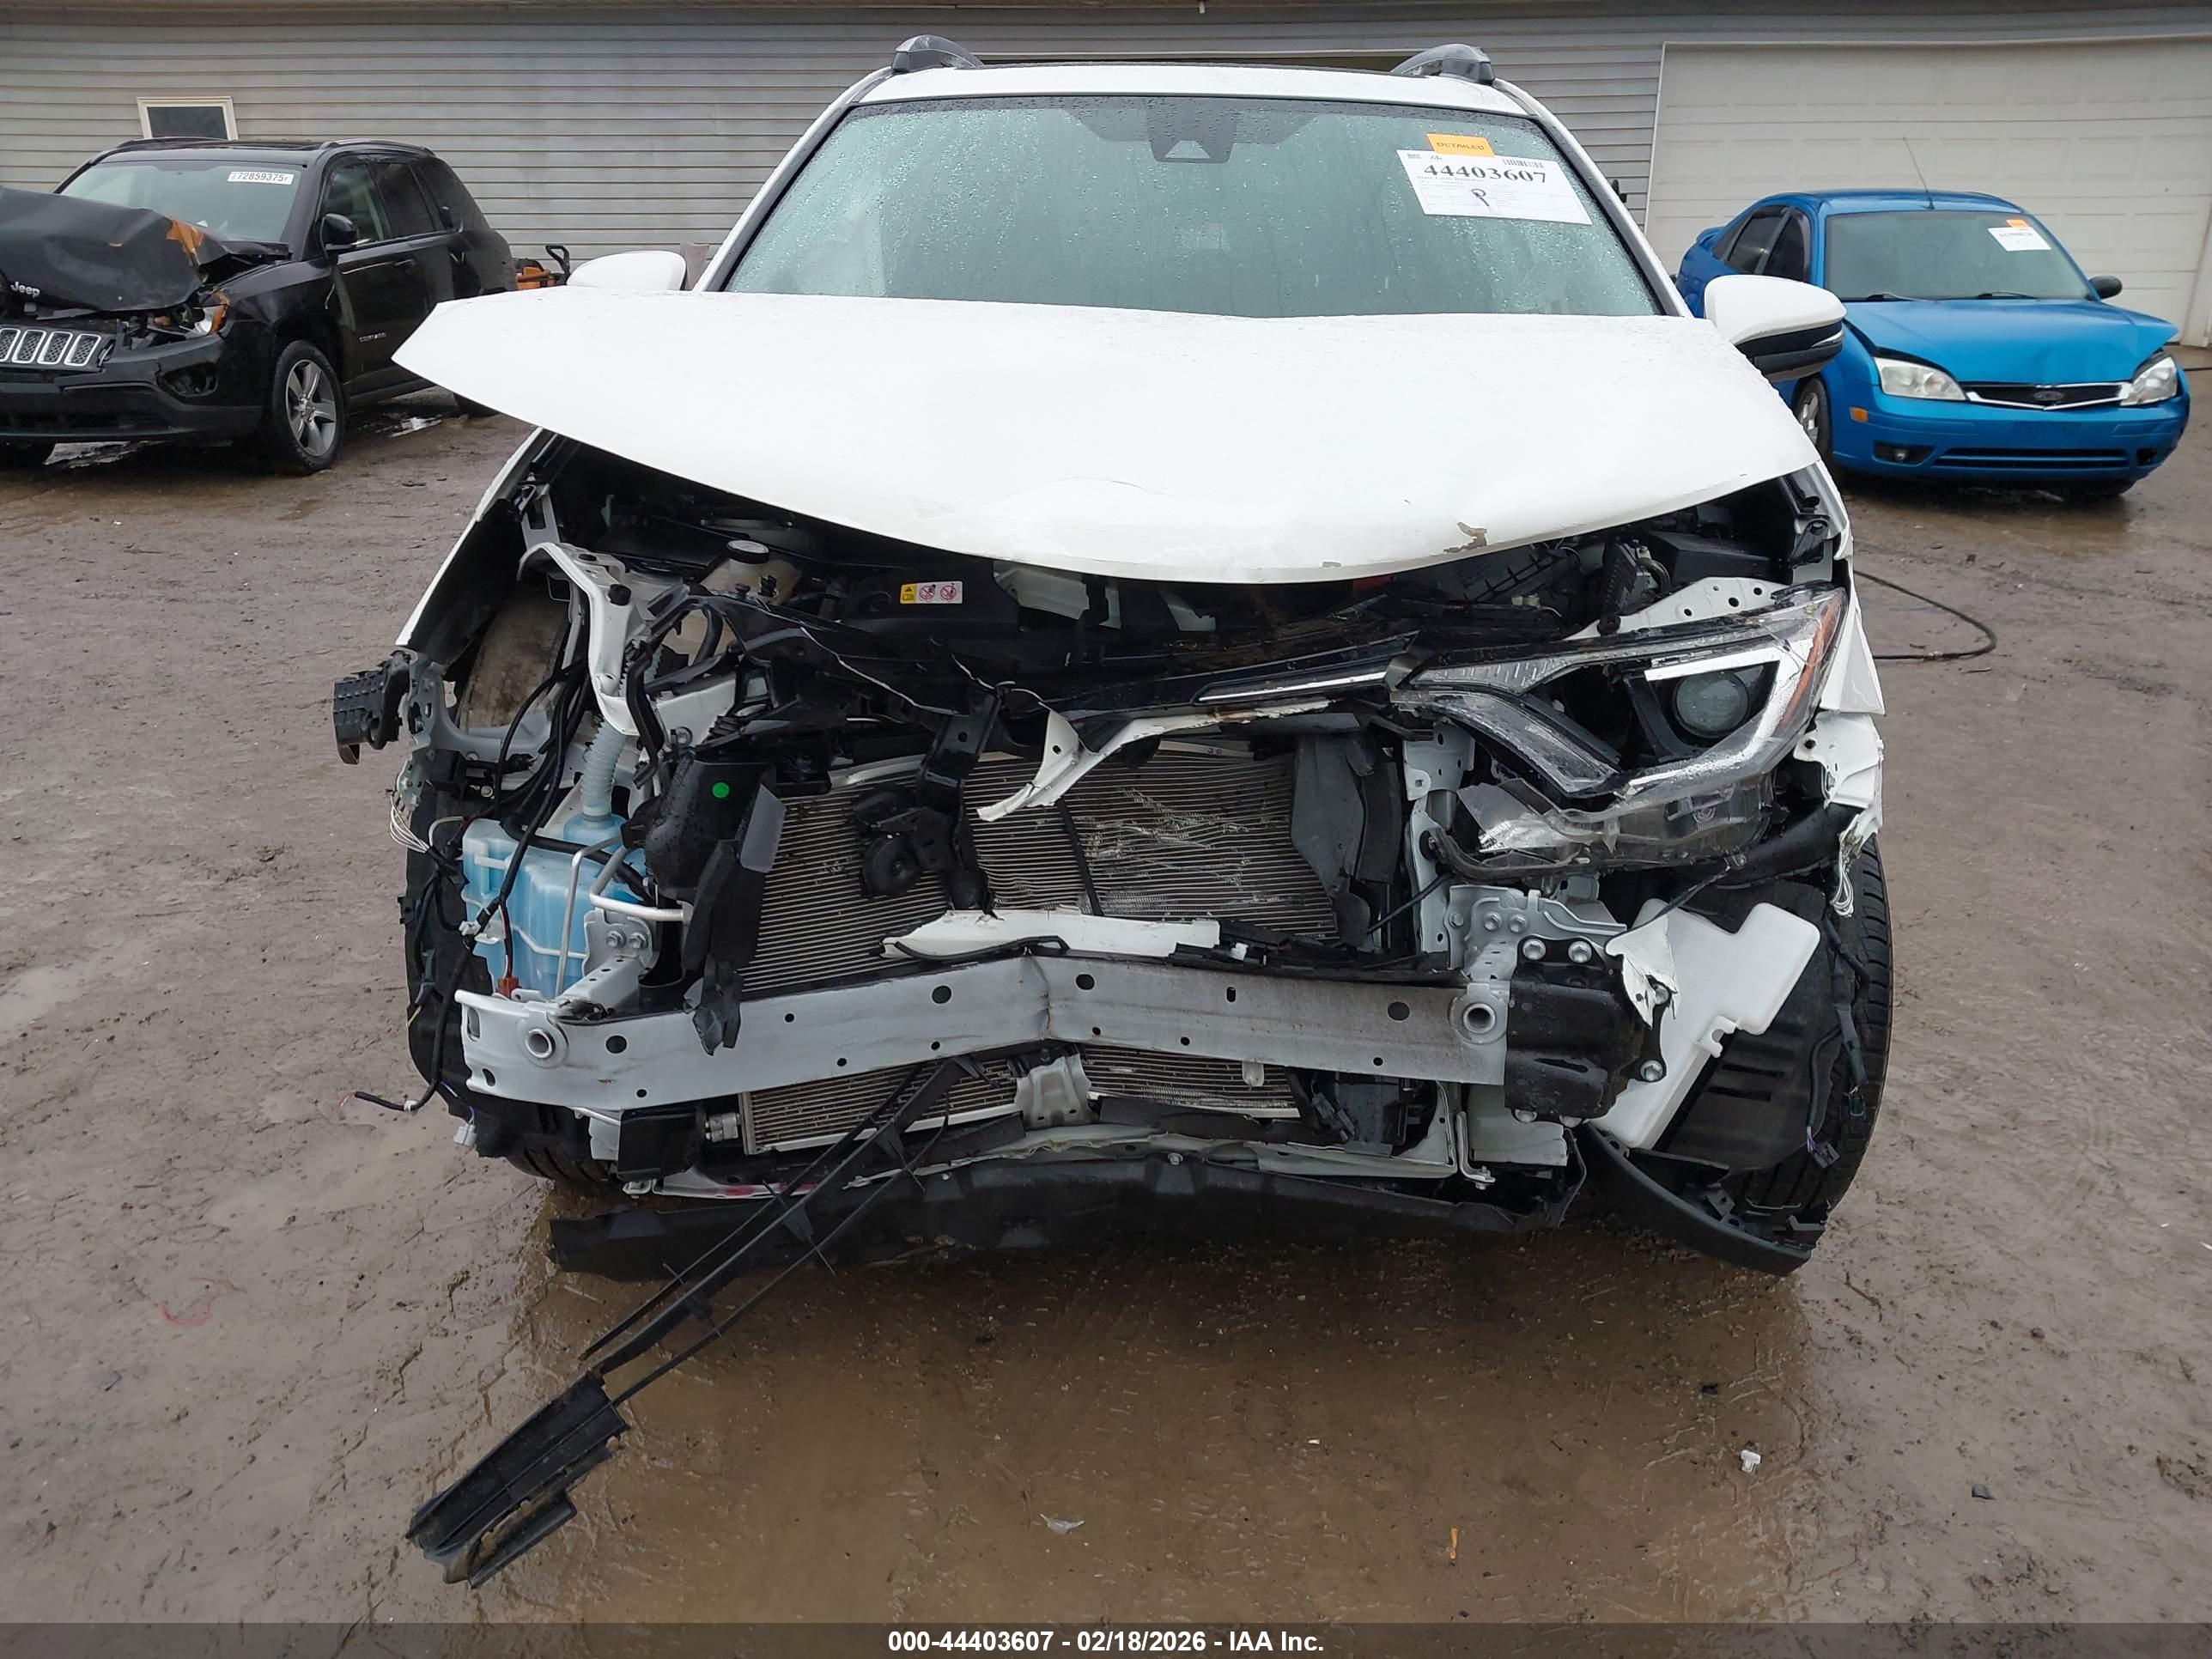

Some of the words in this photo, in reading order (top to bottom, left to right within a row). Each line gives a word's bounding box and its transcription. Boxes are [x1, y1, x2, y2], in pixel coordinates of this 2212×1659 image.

[1436, 142, 1485, 150] DETAILED
[238, 173, 284, 181] 72859375
[1424, 164, 1546, 183] 44403607
[10, 281, 40, 298] Jeep
